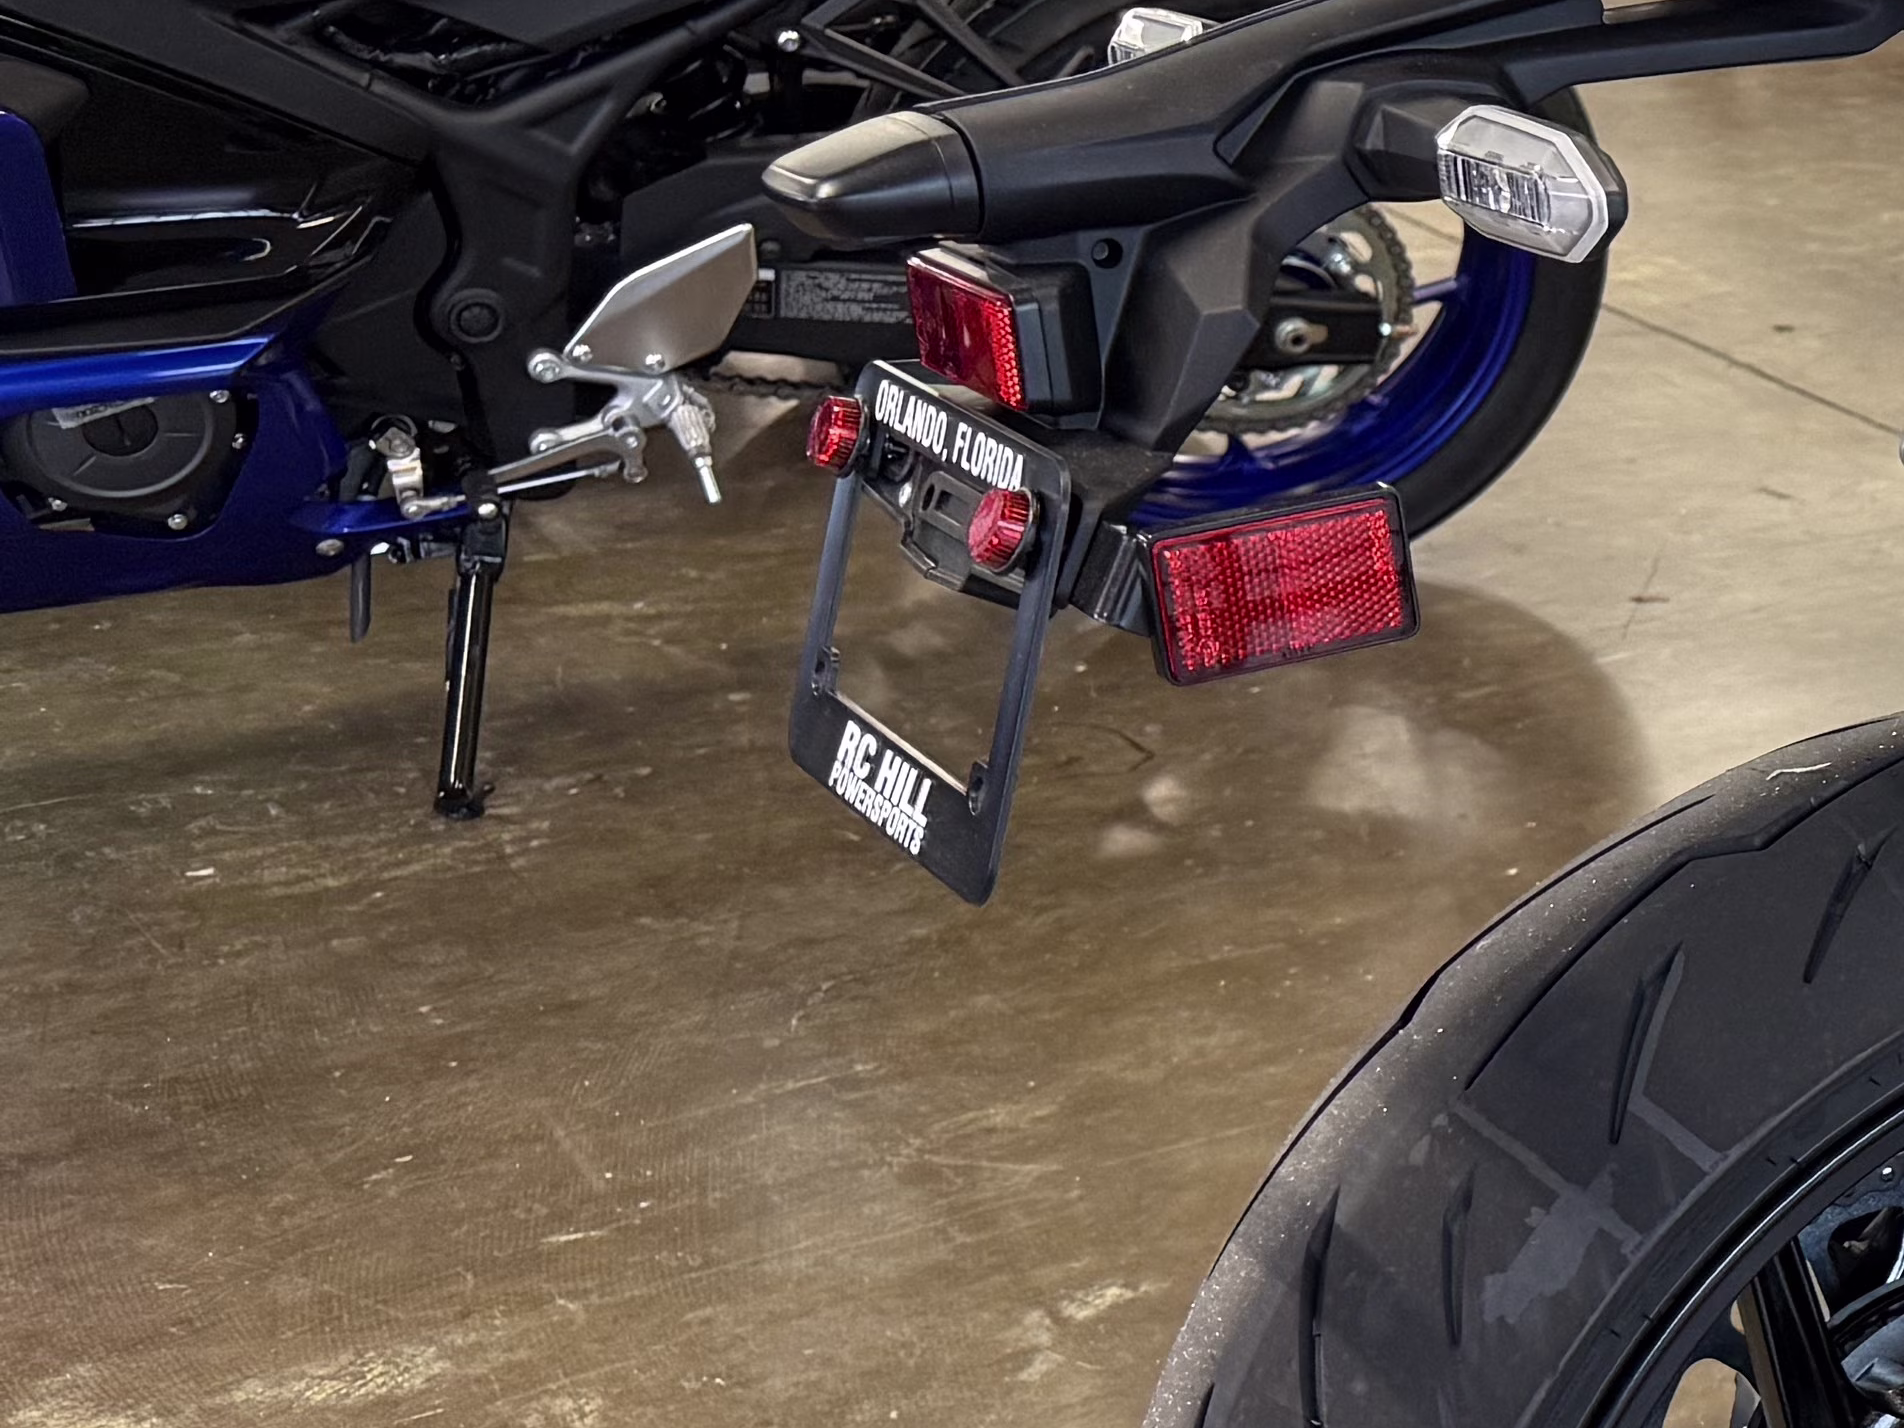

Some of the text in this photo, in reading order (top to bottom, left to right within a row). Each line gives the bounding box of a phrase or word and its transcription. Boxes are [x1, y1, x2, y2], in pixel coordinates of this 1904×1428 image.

[874, 379, 1024, 492] ORLANDO, FLORIDA
[828, 759, 925, 855] POWERSPORTS
[836, 719, 932, 828] RC HILL
